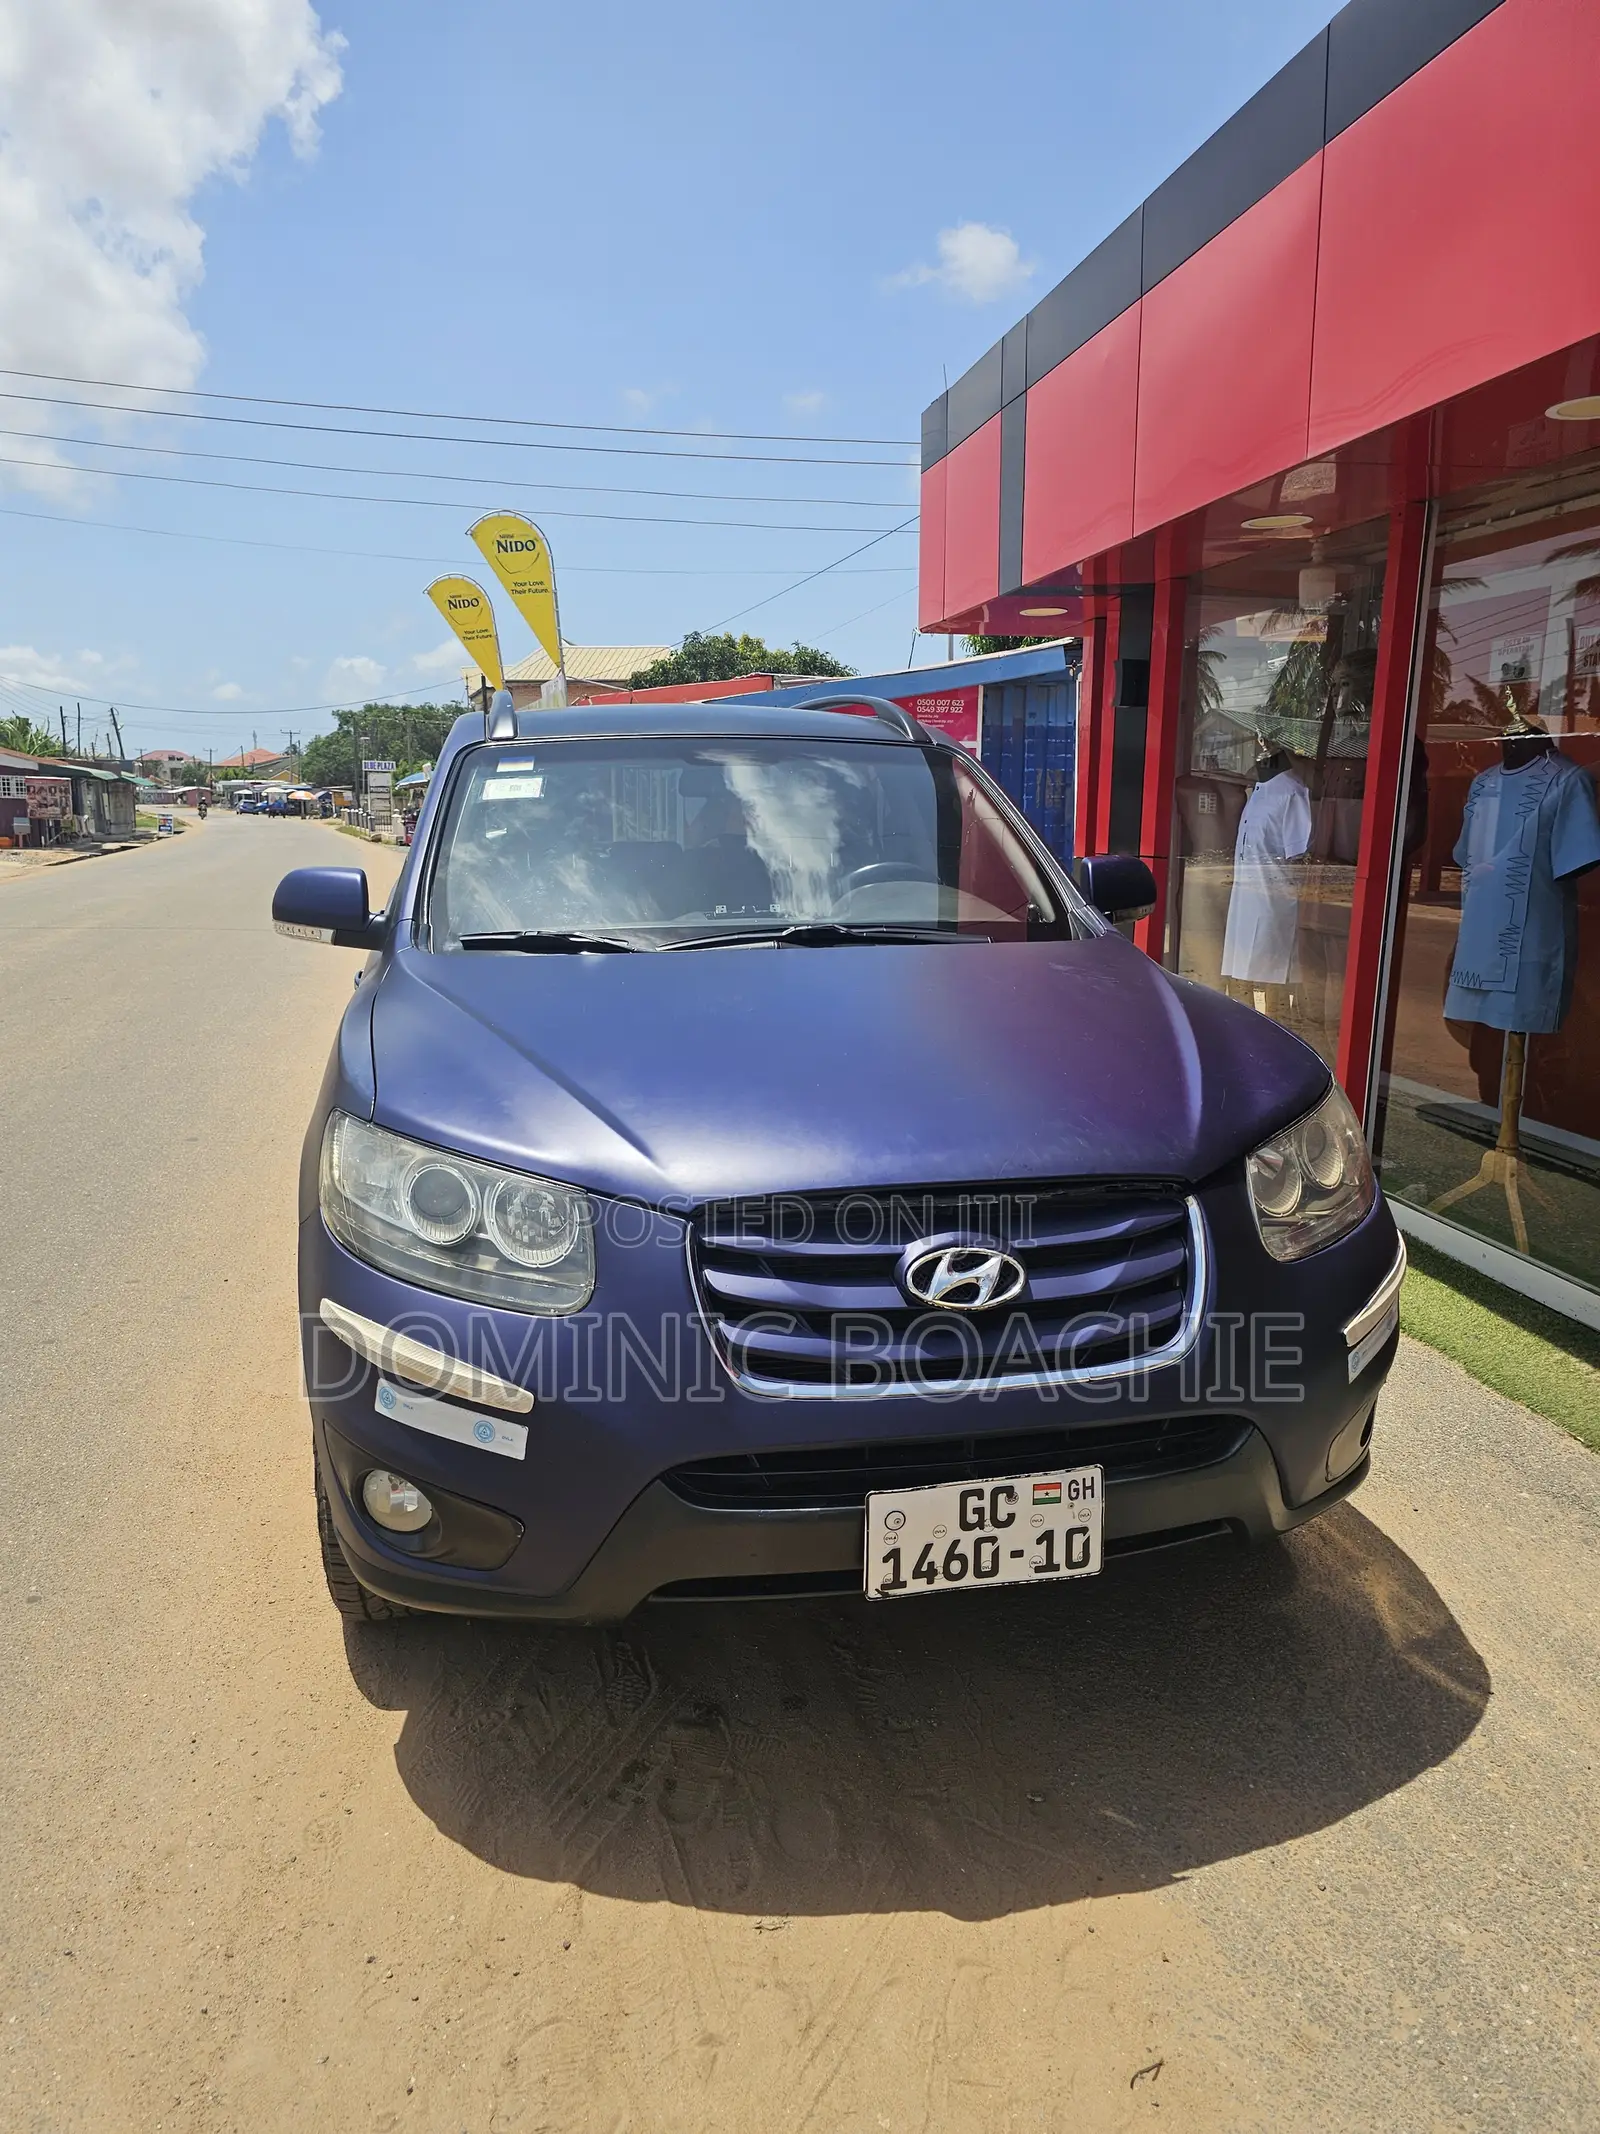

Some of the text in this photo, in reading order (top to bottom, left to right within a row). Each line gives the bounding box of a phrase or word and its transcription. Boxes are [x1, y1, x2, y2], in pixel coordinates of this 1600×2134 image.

[496, 539, 536, 553] NIDO
[448, 598, 480, 610] NIDO
[377, 762, 394, 770] PLAZA
[1067, 1476, 1095, 1501] GH
[959, 1485, 1015, 1532] GC
[880, 1526, 1091, 1591] 1460-10
